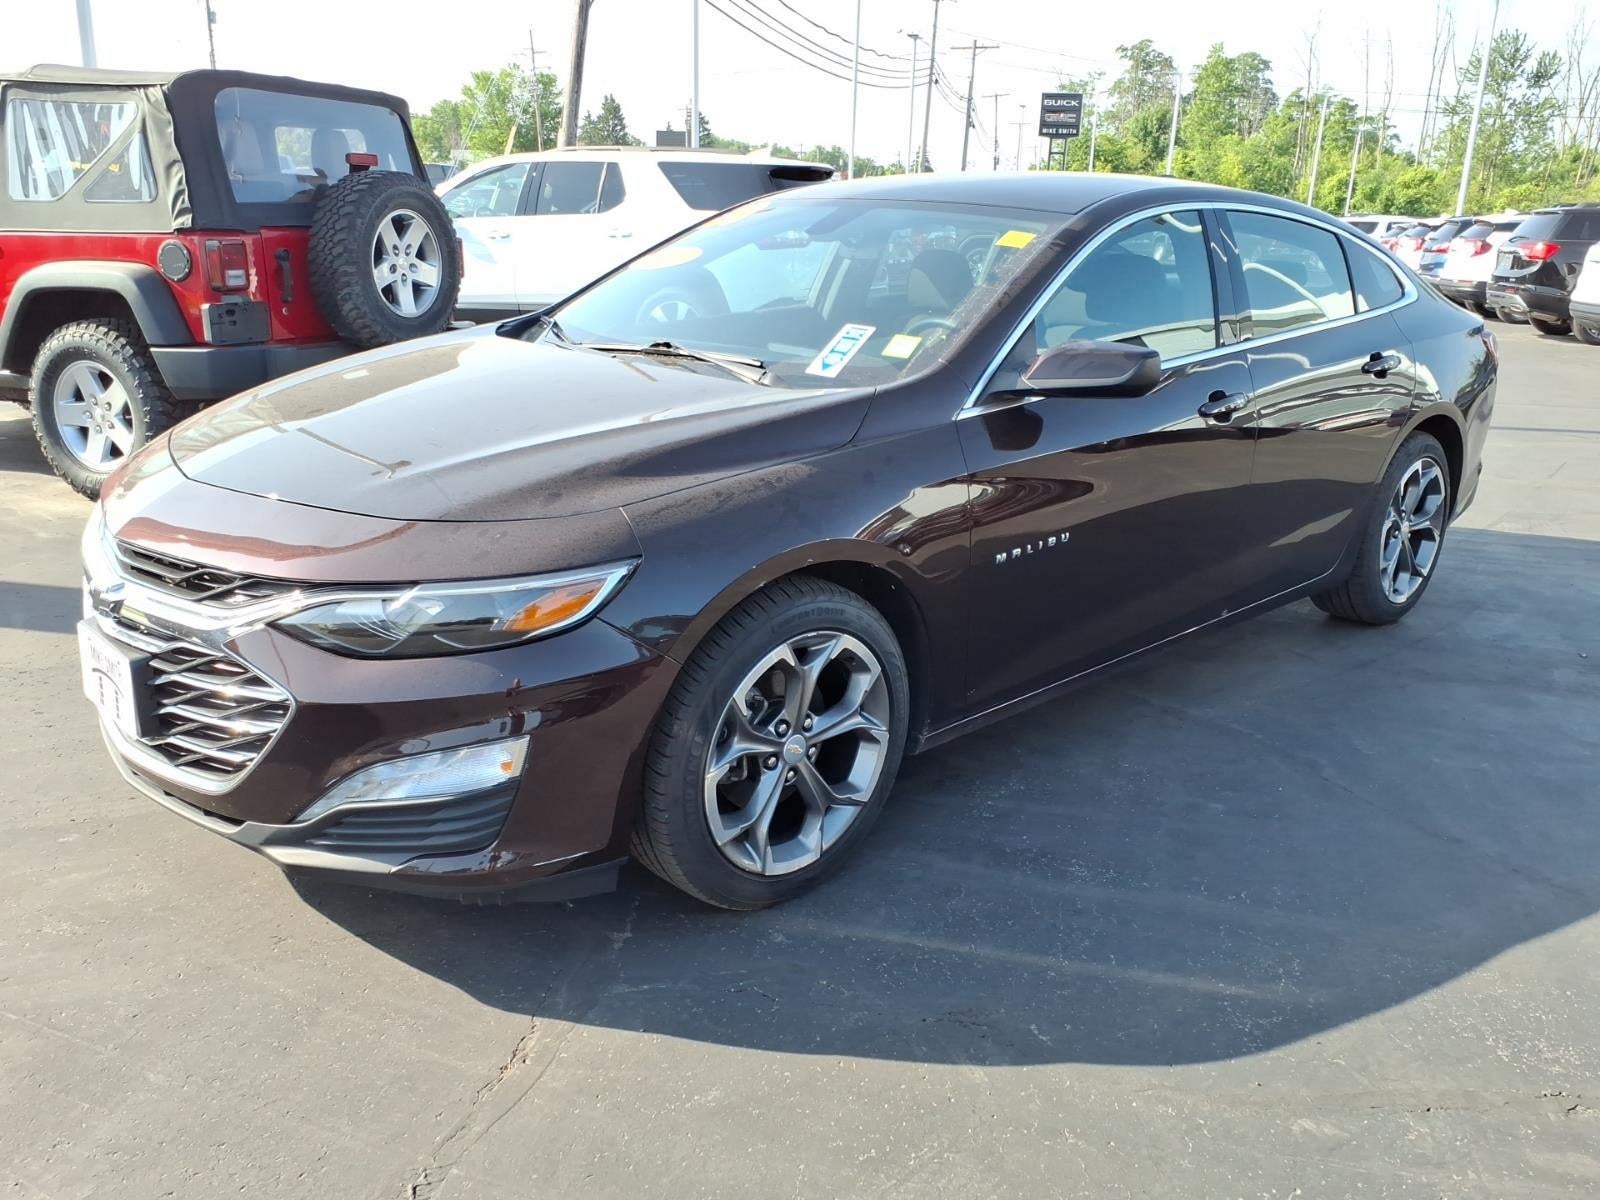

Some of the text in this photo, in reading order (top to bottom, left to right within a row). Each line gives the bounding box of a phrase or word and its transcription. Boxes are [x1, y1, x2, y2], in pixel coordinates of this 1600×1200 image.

[1044, 99, 1079, 107] BUICK
[1045, 113, 1076, 123] GMC
[995, 532, 1070, 564] MALIBU
